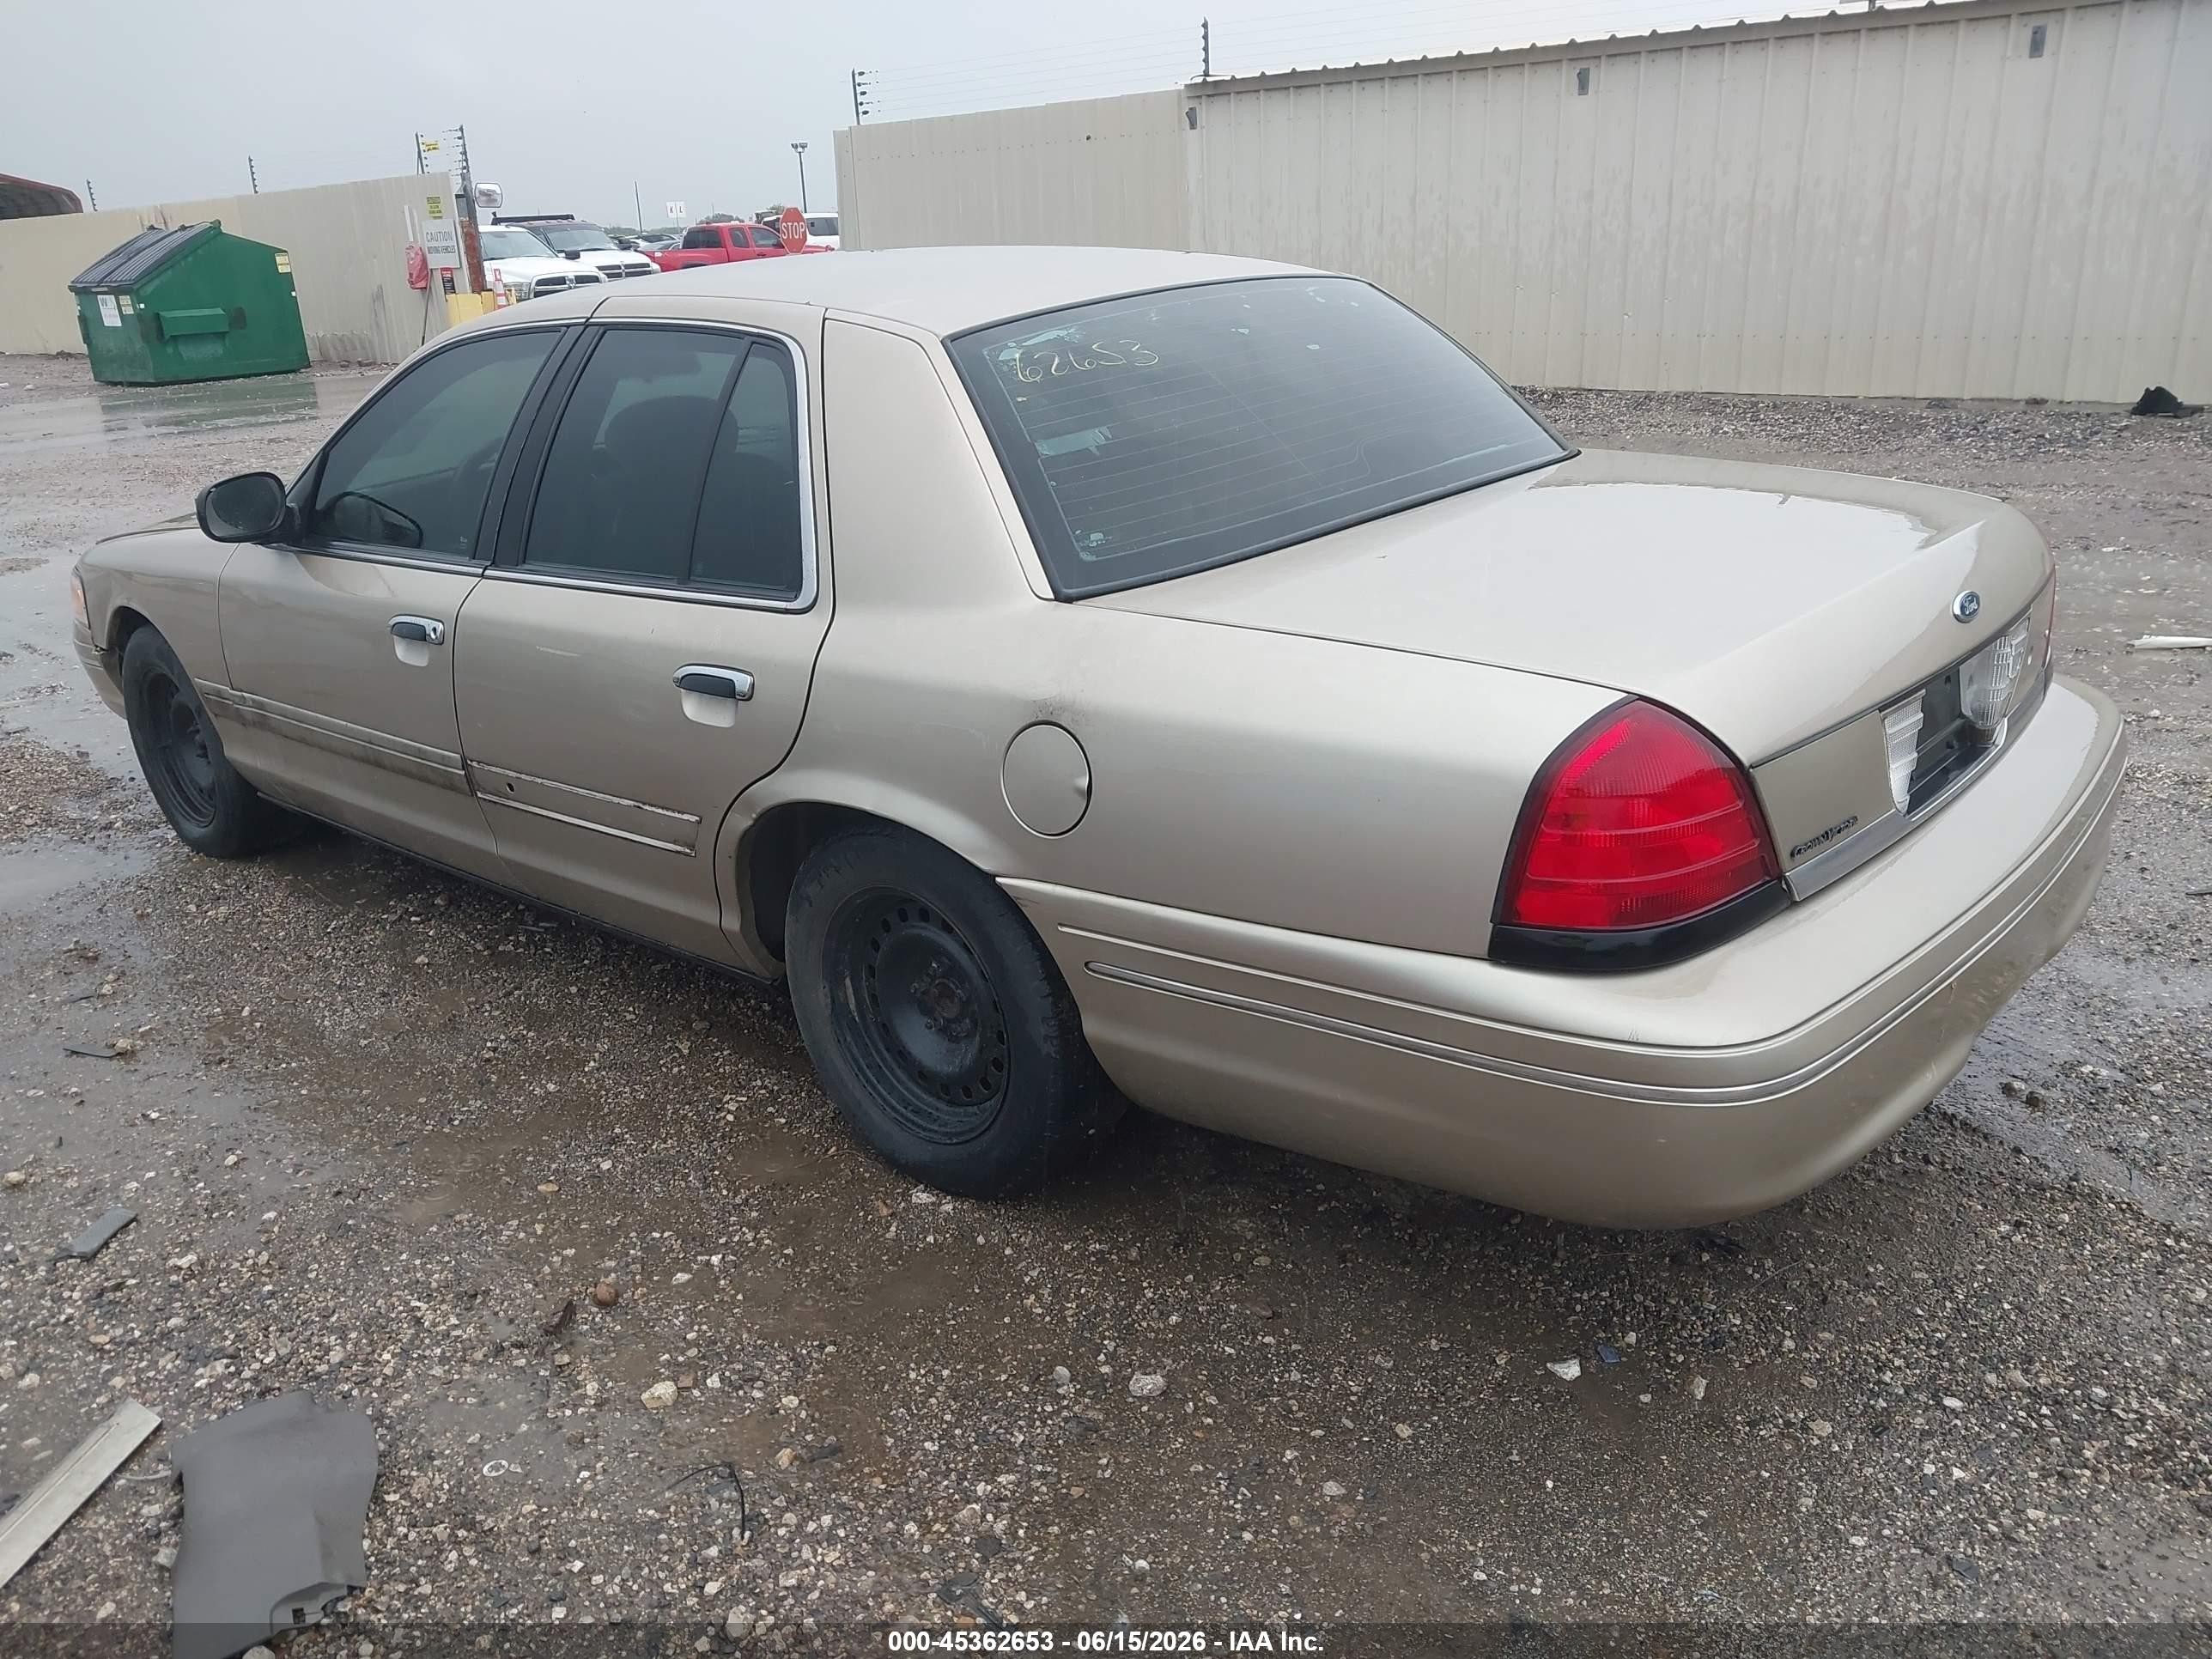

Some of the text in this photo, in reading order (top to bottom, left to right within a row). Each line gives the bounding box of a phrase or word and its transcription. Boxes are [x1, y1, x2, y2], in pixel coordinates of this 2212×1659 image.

[426, 231, 454, 242] CAUTION
[781, 222, 805, 240] STOP
[441, 245, 456, 254] VEHICLES
[1015, 339, 1159, 383] 62653
